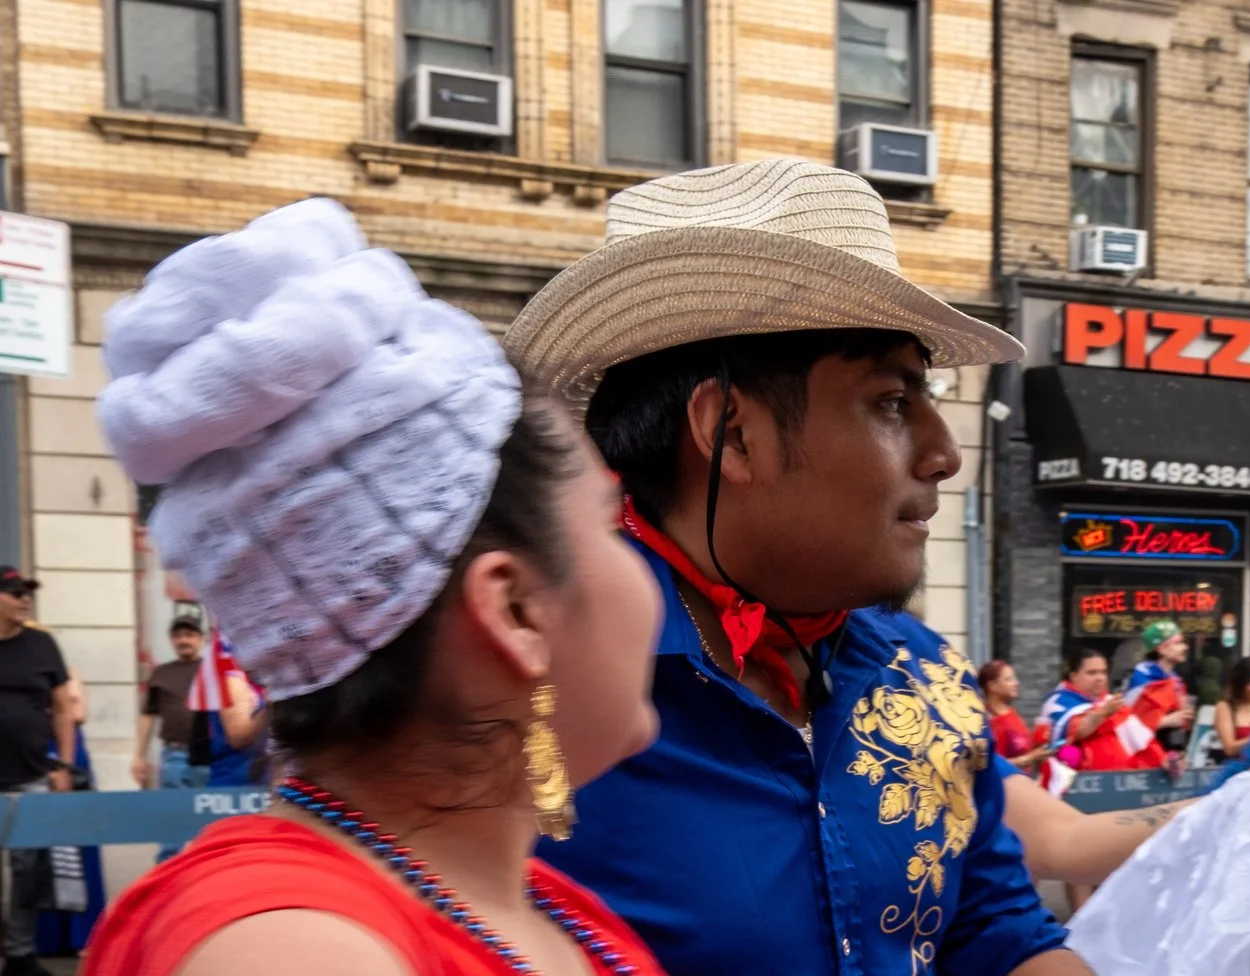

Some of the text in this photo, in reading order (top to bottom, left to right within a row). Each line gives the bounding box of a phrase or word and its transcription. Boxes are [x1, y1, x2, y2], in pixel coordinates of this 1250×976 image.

[1038, 457, 1081, 482] PIZZA
[1102, 457, 1147, 481] 718
[1120, 518, 1225, 555] Heros
[1081, 590, 1220, 616] FREE DELIVERY
